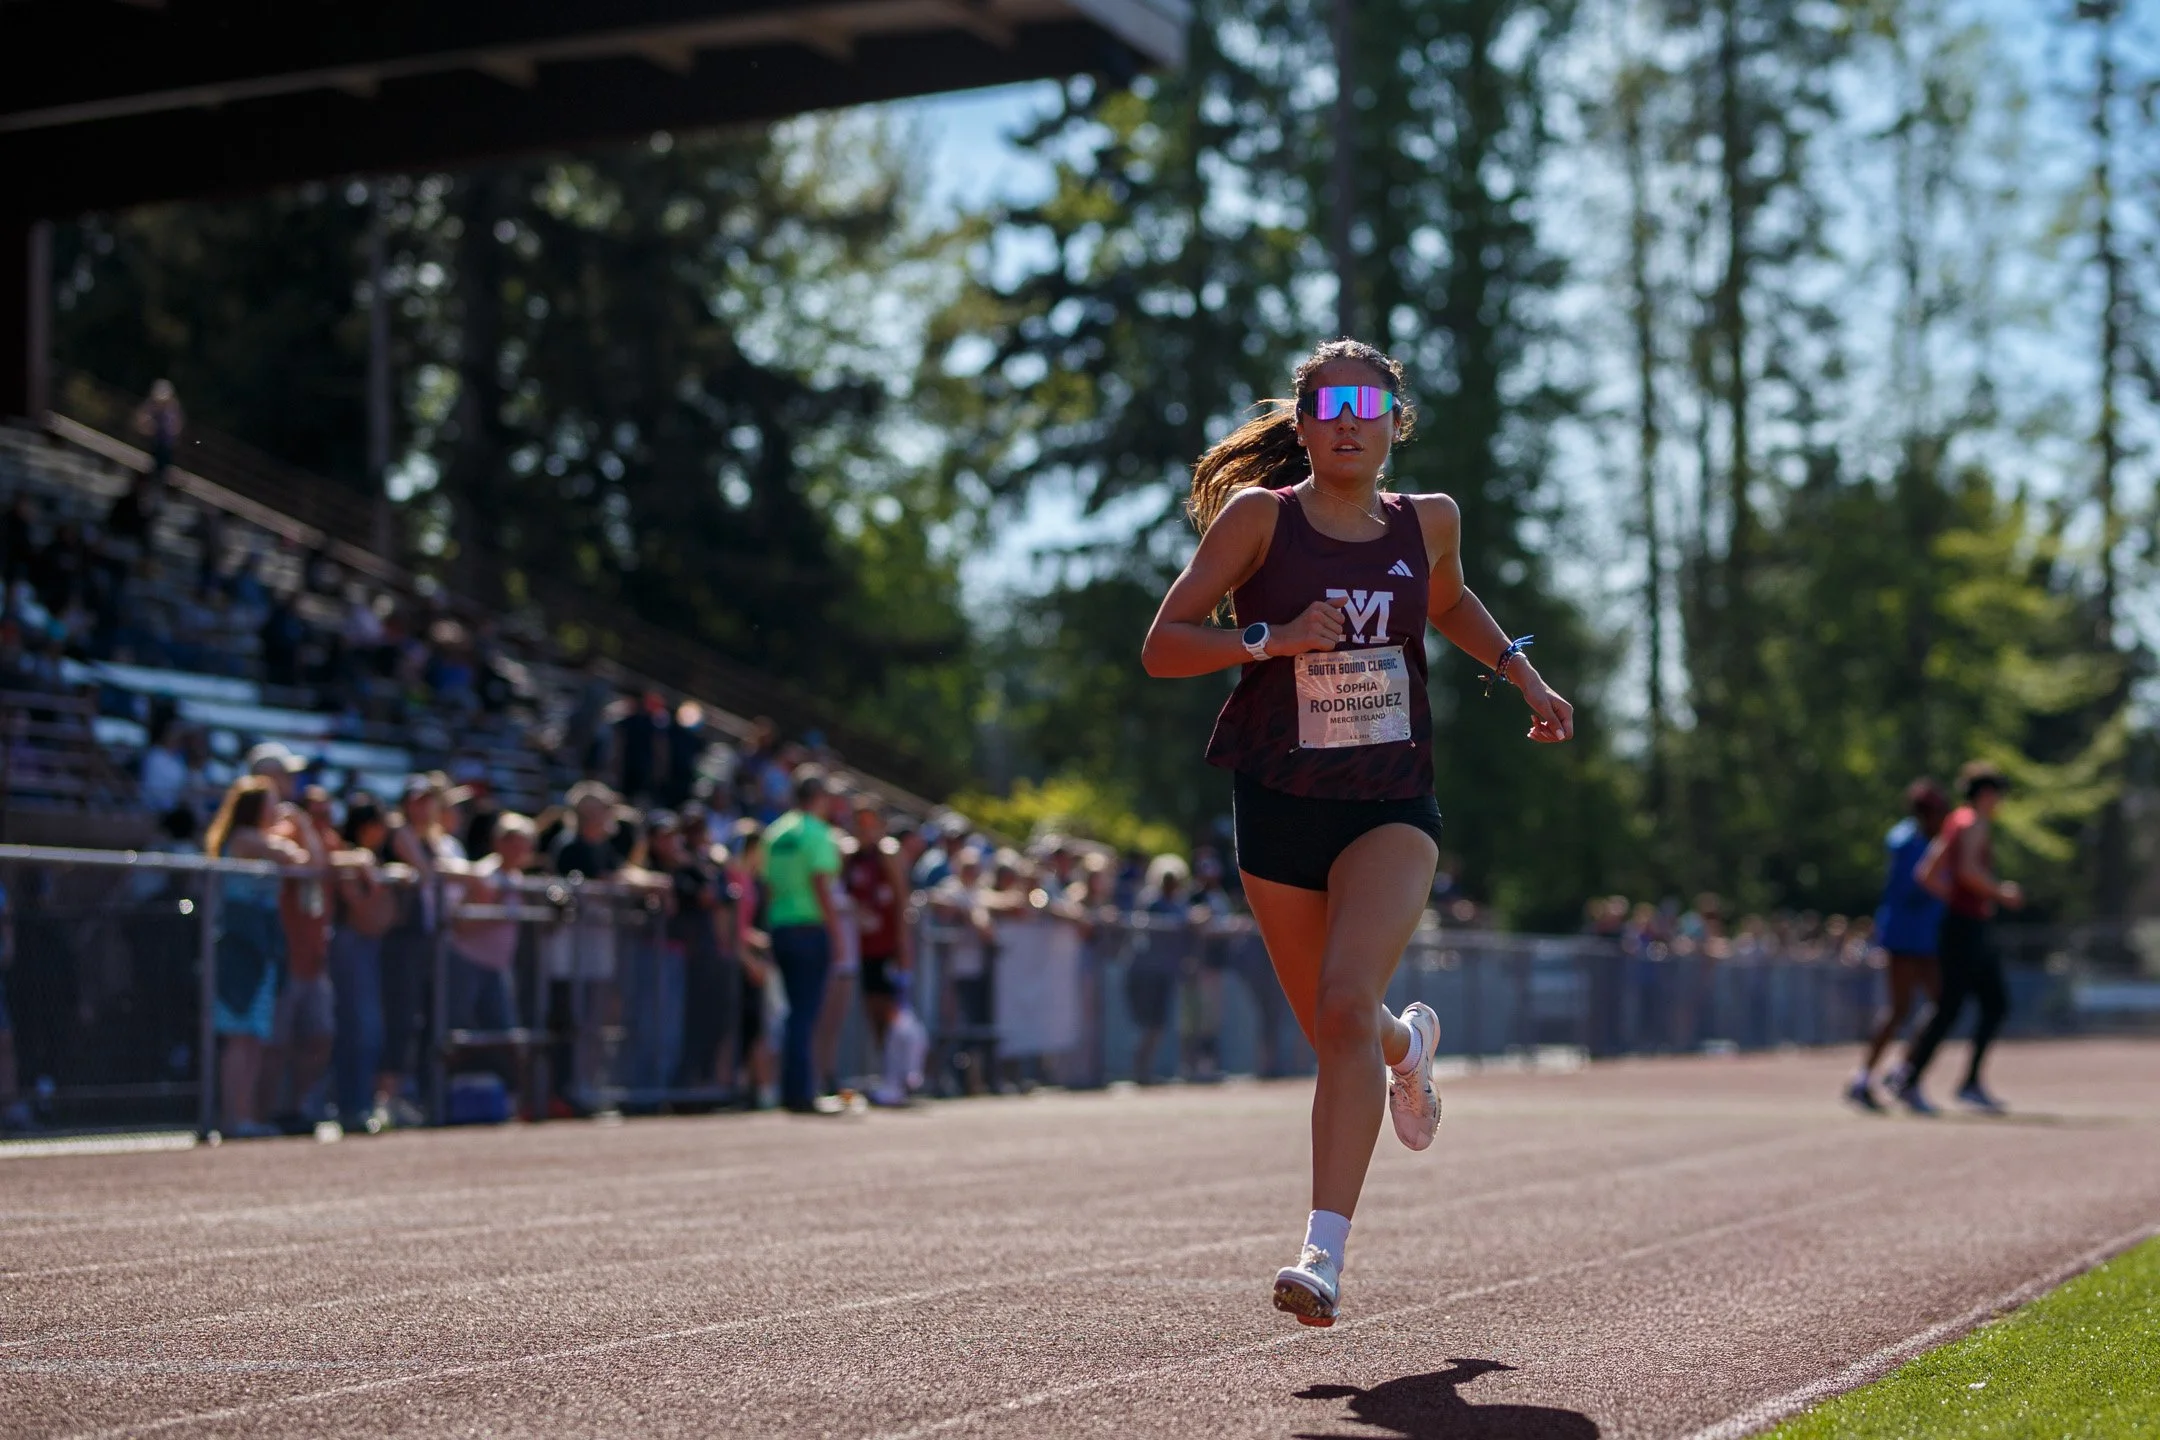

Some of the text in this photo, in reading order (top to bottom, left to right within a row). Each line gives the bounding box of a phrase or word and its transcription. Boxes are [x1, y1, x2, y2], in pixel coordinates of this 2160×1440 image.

[1308, 658, 1398, 676] SOUTH SOUND CLASSIC
[1336, 682, 1378, 694] SOPHIA
[1310, 692, 1402, 713] RODRIGUEZ
[1330, 712, 1386, 724] MERCER ISLAND
